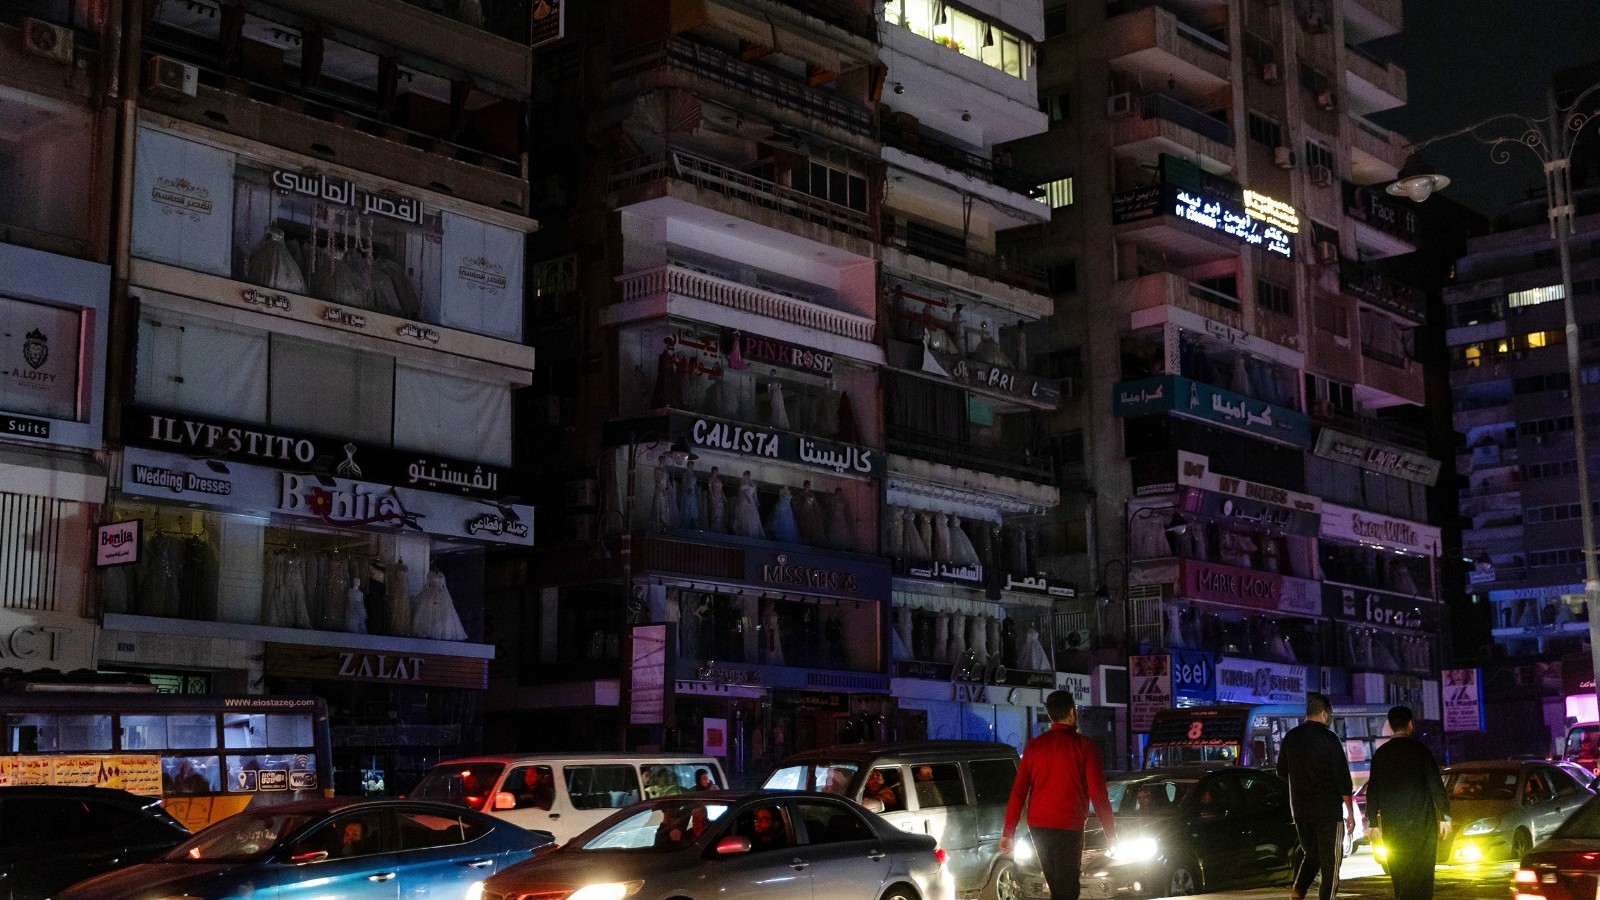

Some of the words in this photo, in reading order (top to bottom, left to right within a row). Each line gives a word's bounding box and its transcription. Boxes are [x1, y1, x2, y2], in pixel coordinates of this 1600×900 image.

[273, 170, 356, 207] الماسي
[363, 194, 424, 225] القصر
[1212, 393, 1273, 427] كراميلا
[8, 420, 47, 435] Suits
[150, 415, 316, 464] ILVESTITO
[693, 419, 779, 458] CALISTA
[799, 438, 872, 473] كاليستا
[135, 466, 184, 492] Wedding
[188, 473, 231, 494] Dresses
[1198, 568, 1236, 593] MARIE
[1240, 576, 1275, 599] MODE
[0, 625, 72, 661] CT
[337, 652, 425, 681] ZALAT
[1187, 721, 1204, 740] 8
